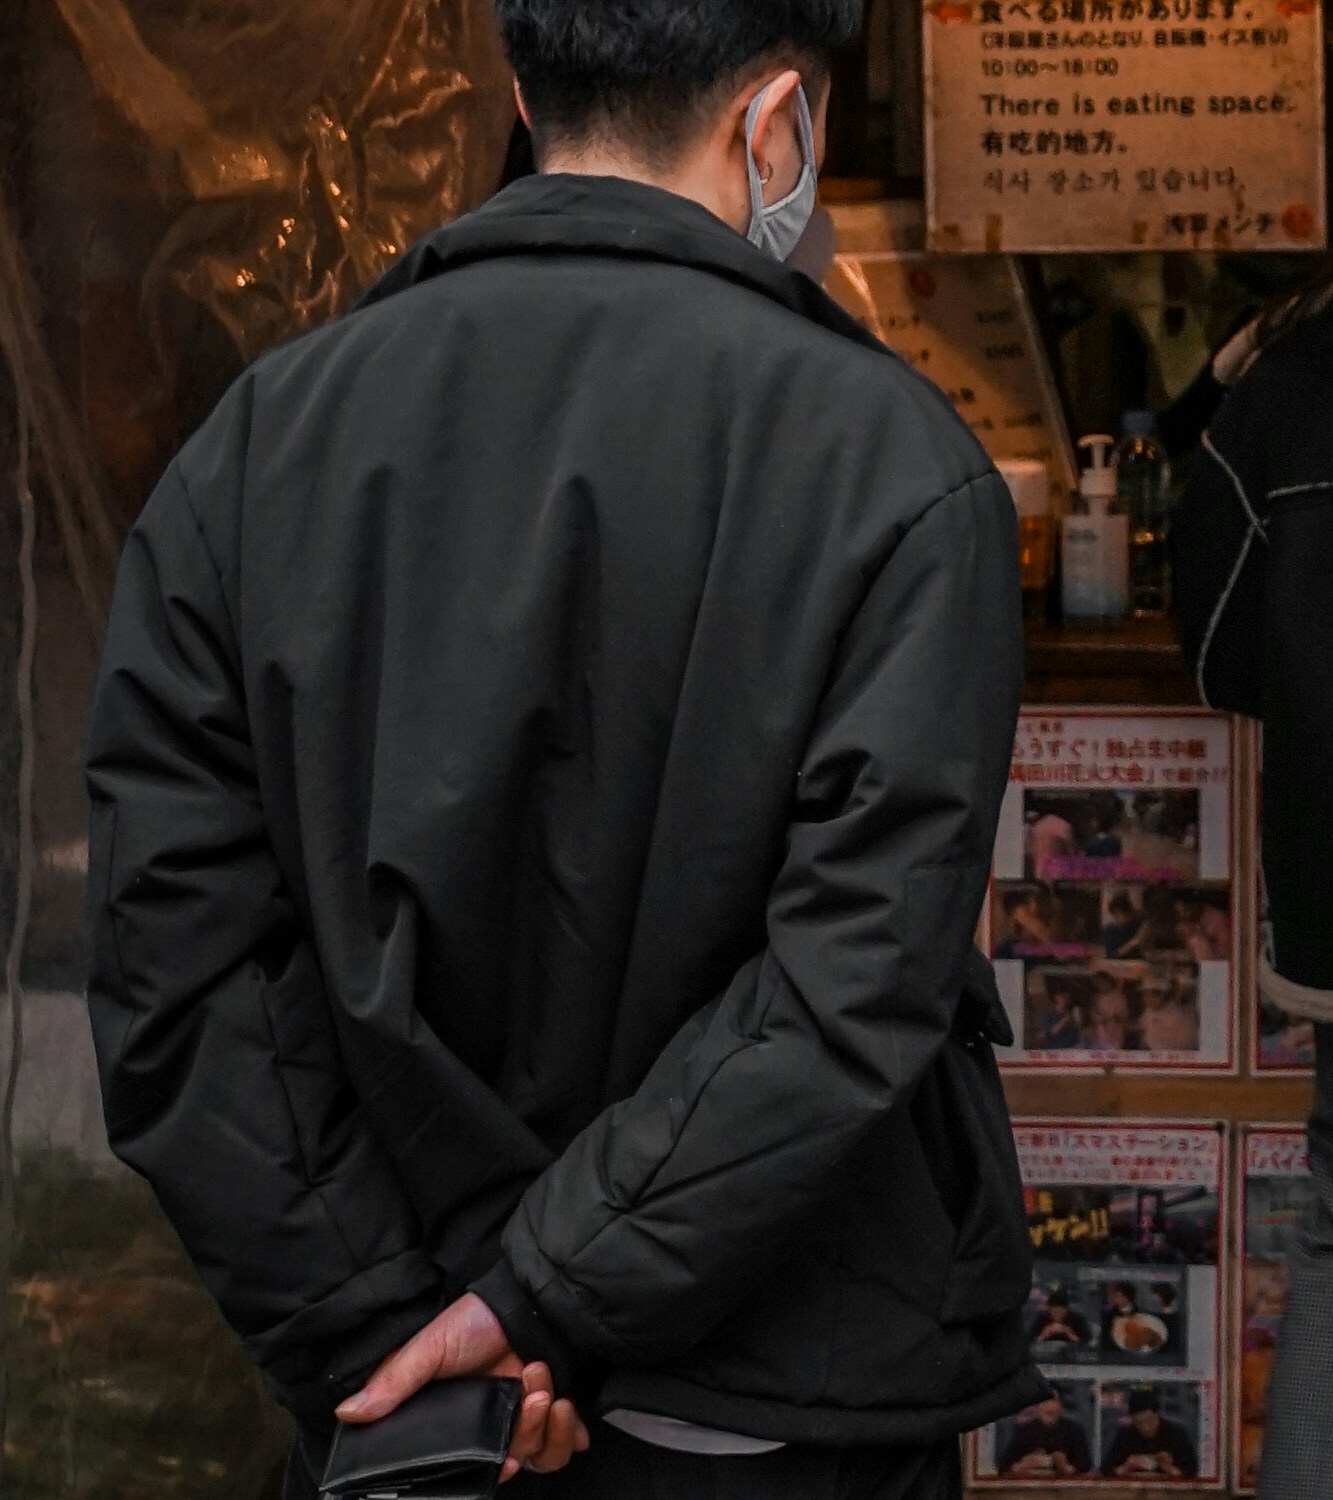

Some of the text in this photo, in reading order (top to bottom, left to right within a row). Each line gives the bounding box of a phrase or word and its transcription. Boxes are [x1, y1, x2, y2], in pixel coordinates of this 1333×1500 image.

[979, 93, 1061, 117] There
[1073, 92, 1097, 116] is
[1107, 95, 1197, 118] eating
